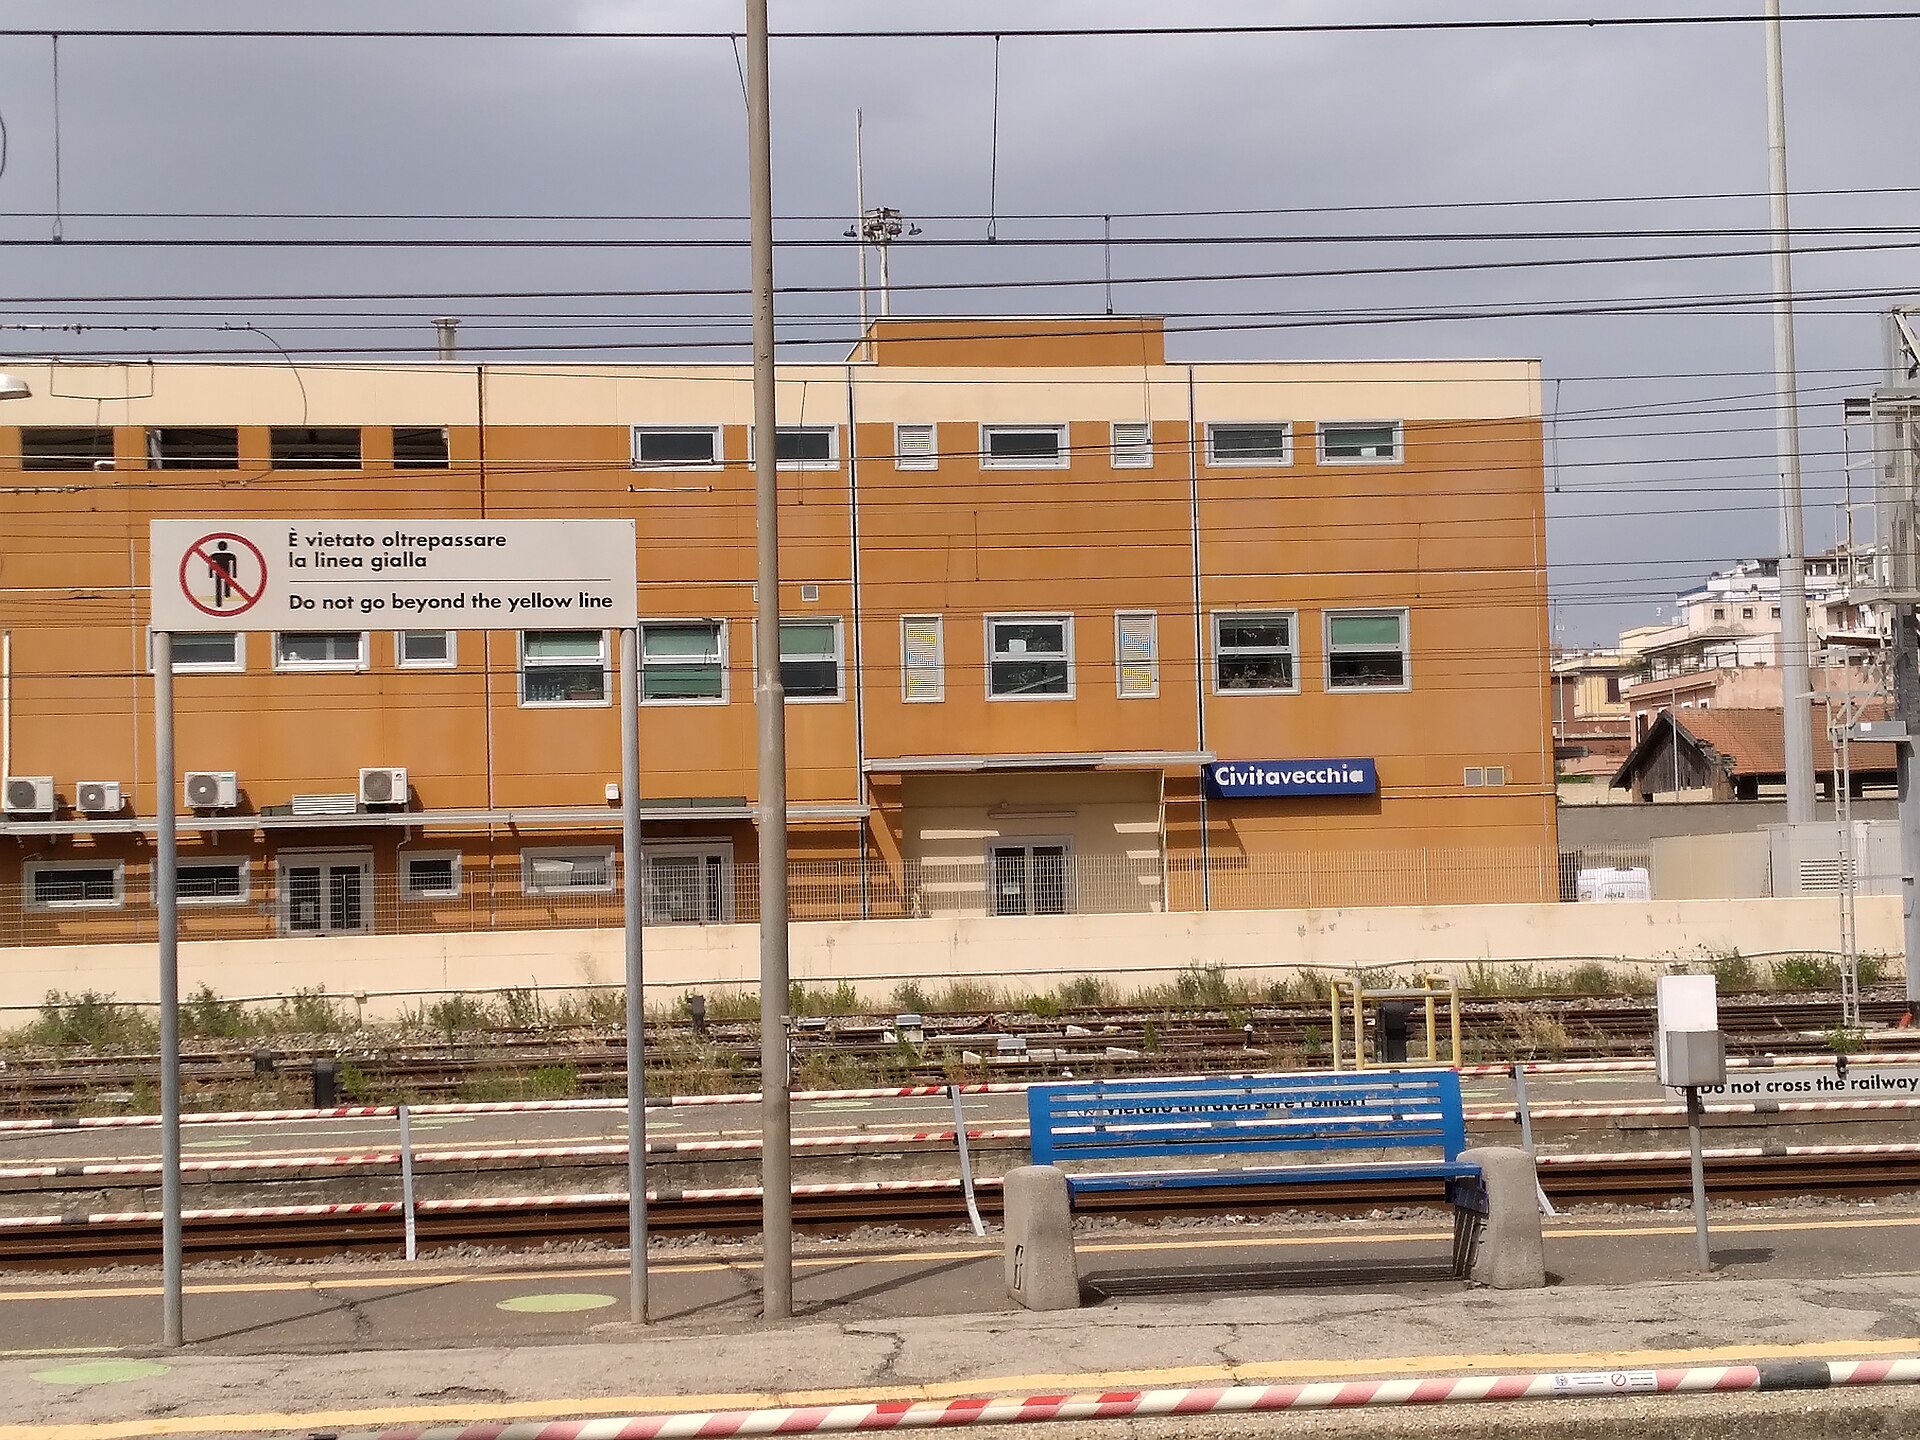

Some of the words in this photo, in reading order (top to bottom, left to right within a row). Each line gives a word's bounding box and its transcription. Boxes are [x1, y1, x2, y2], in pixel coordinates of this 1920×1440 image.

[288, 527, 298, 547] È
[305, 530, 375, 547] vietato
[382, 529, 507, 550] oltrepassare
[289, 551, 307, 568] la
[314, 551, 363, 568] linea
[370, 550, 427, 572] gialla
[289, 594, 315, 610] Do
[323, 595, 355, 610] not
[361, 597, 385, 614] go
[391, 592, 465, 614] beyond
[471, 592, 502, 609] the
[507, 591, 573, 613] yellow
[579, 591, 613, 608] line
[1214, 763, 1364, 786] Civitavecchia
[1731, 1080, 1760, 1094] not
[1766, 1080, 1812, 1093] cross
[1815, 1075, 1846, 1091] the
[1850, 1074, 1919, 1092] railway
